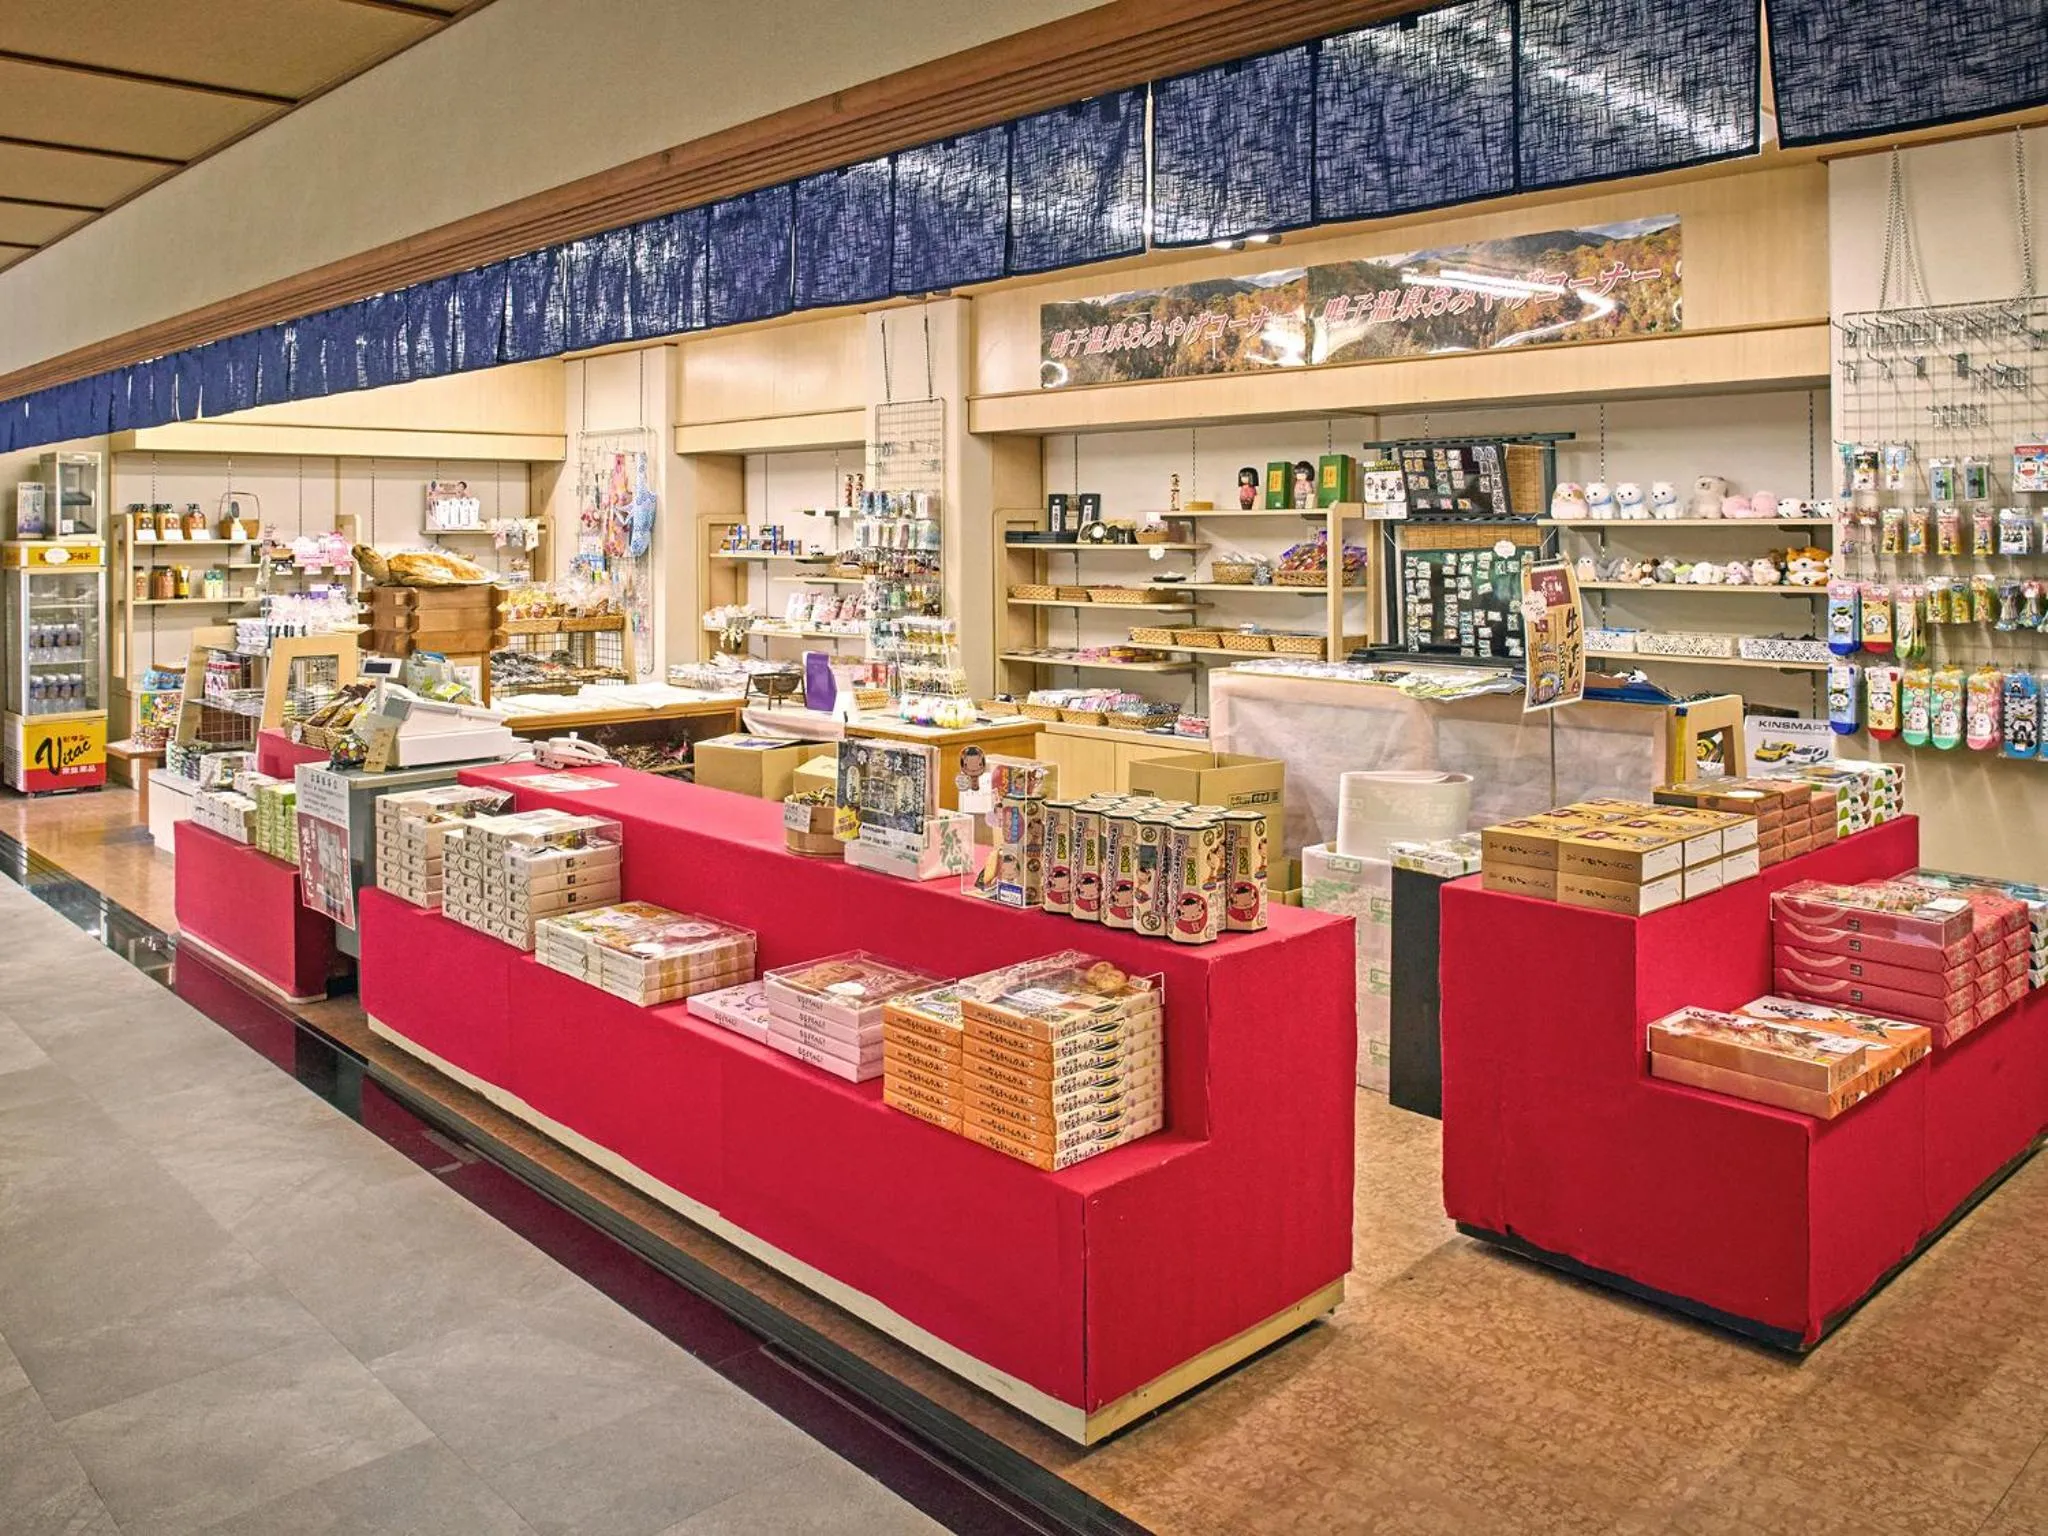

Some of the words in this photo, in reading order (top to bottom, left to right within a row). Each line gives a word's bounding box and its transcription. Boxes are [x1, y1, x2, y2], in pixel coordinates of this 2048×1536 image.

[1050, 306, 1298, 357] 鳴子温泉おみやげコーナー
[1566, 608, 1580, 679] 牛たん
[1758, 720, 1830, 731] KINSMART
[35, 736, 91, 776] Vitac
